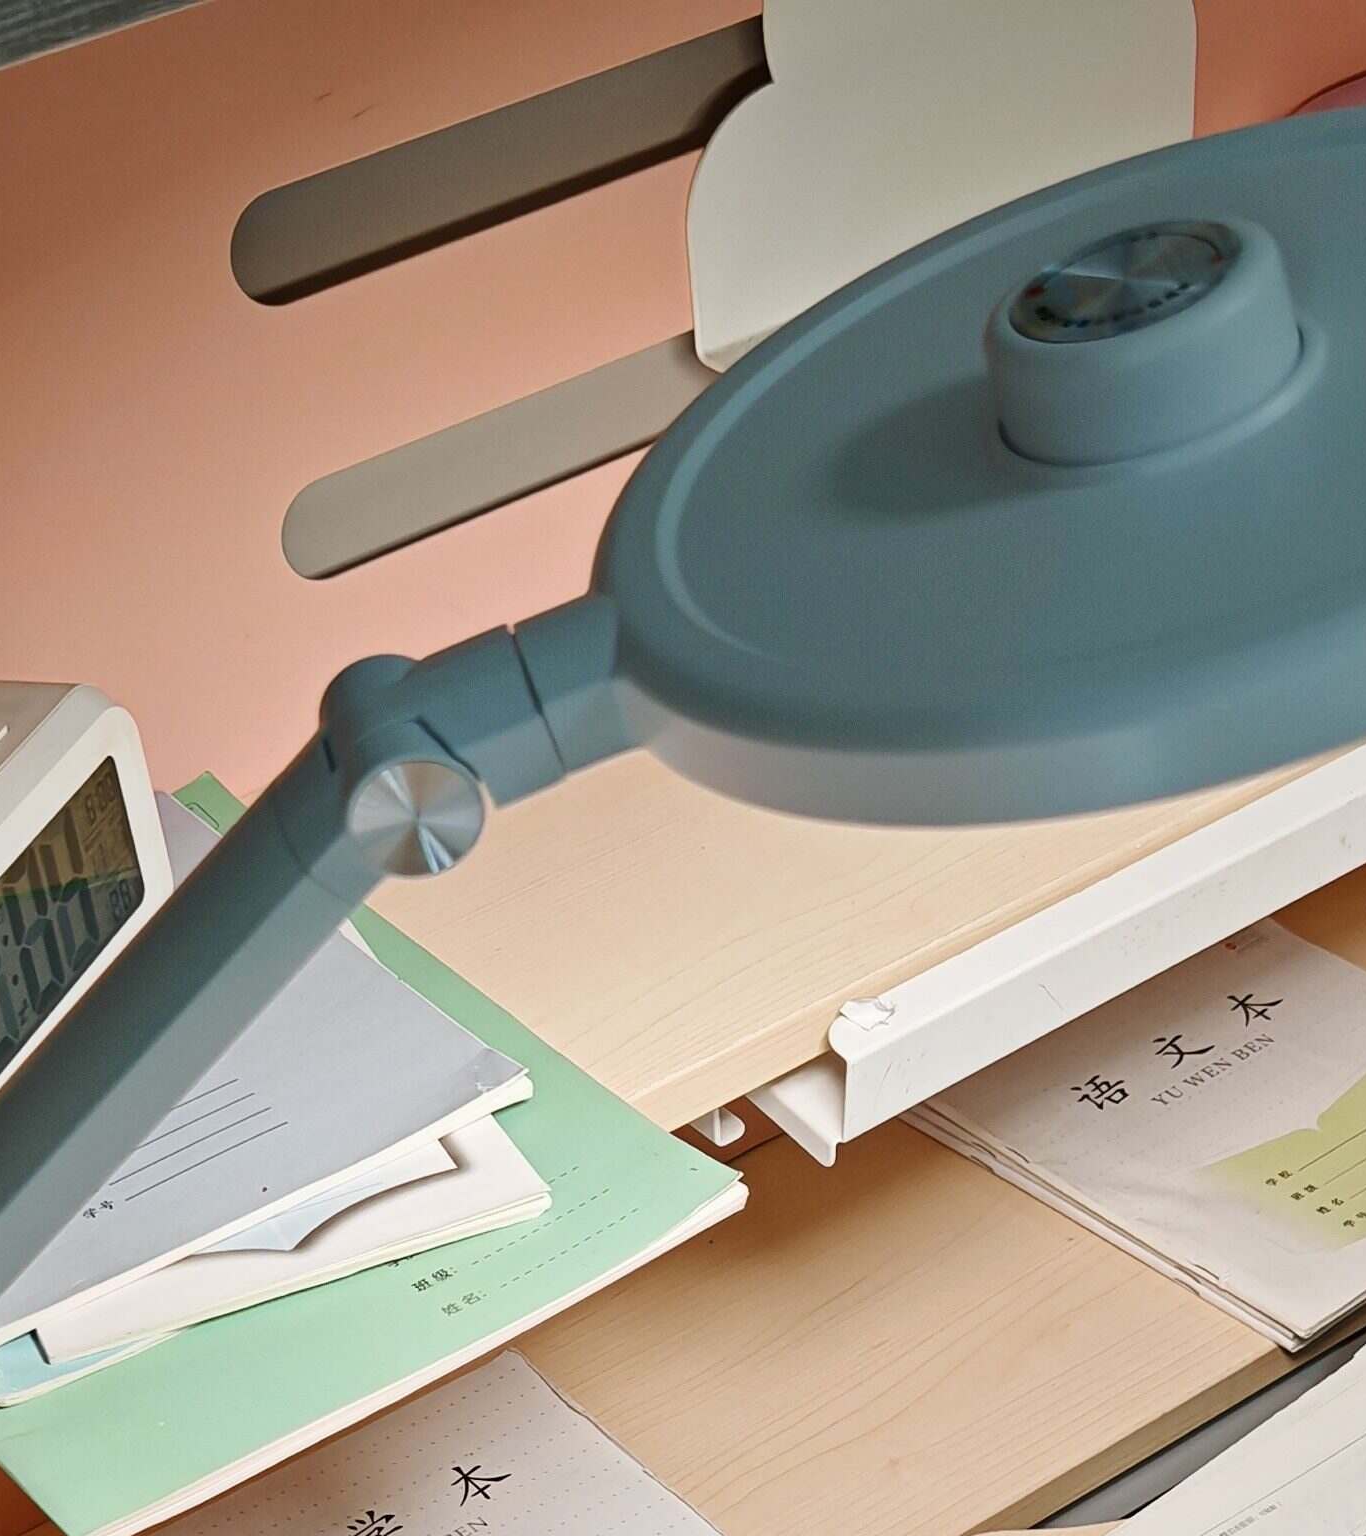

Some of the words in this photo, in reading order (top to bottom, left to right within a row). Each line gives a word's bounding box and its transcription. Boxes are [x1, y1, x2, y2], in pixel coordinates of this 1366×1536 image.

[1071, 993, 1283, 1111] 语文本
[1150, 1084, 1186, 1108] YU
[1183, 1058, 1233, 1089] WEN
[1231, 1032, 1276, 1062] BEN
[1264, 1169, 1294, 1187] 学校
[81, 1200, 117, 1221] 学号
[1315, 1197, 1345, 1215] 姓名
